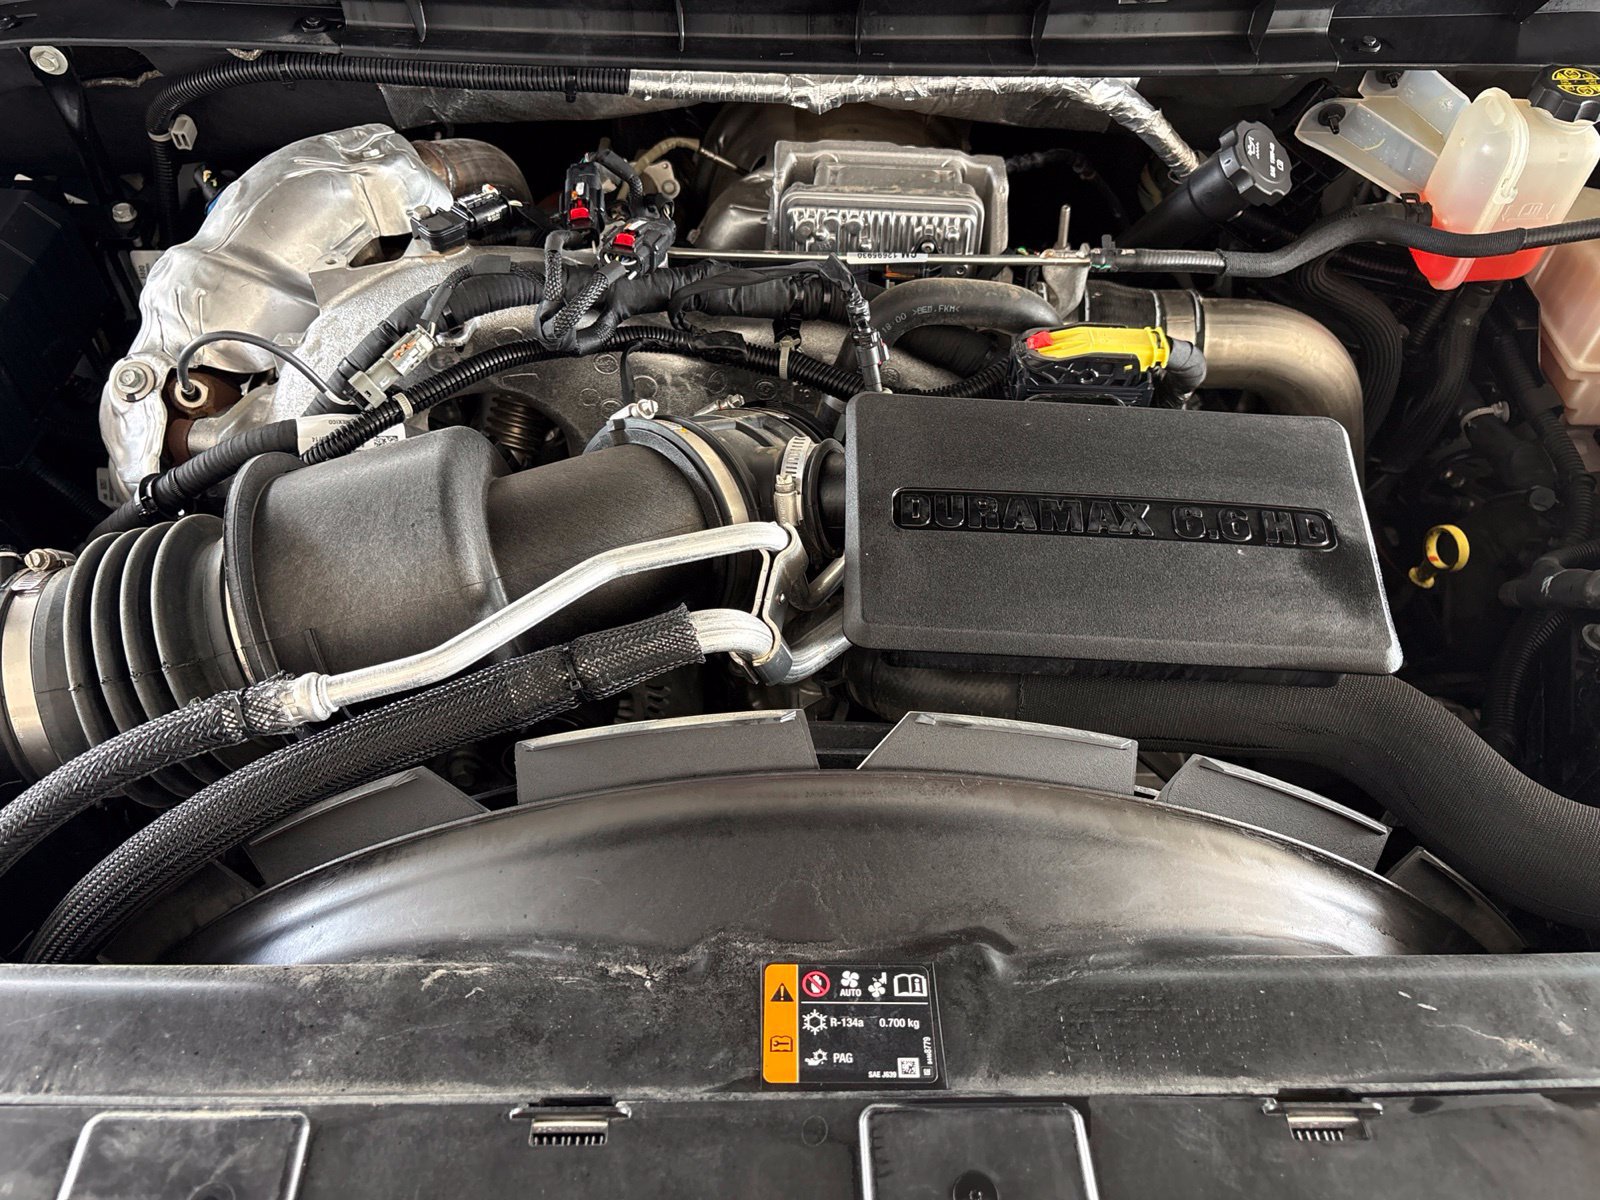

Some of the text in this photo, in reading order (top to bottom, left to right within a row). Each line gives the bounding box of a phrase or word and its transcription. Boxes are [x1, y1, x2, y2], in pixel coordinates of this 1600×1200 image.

[899, 493, 1331, 547] DURAMAX 6.6 HD
[839, 988, 862, 997] AUTO
[829, 1017, 920, 1030] R-134a 0.700 kg
[832, 1052, 854, 1064] PAG
[867, 1070, 881, 1079] SAE
